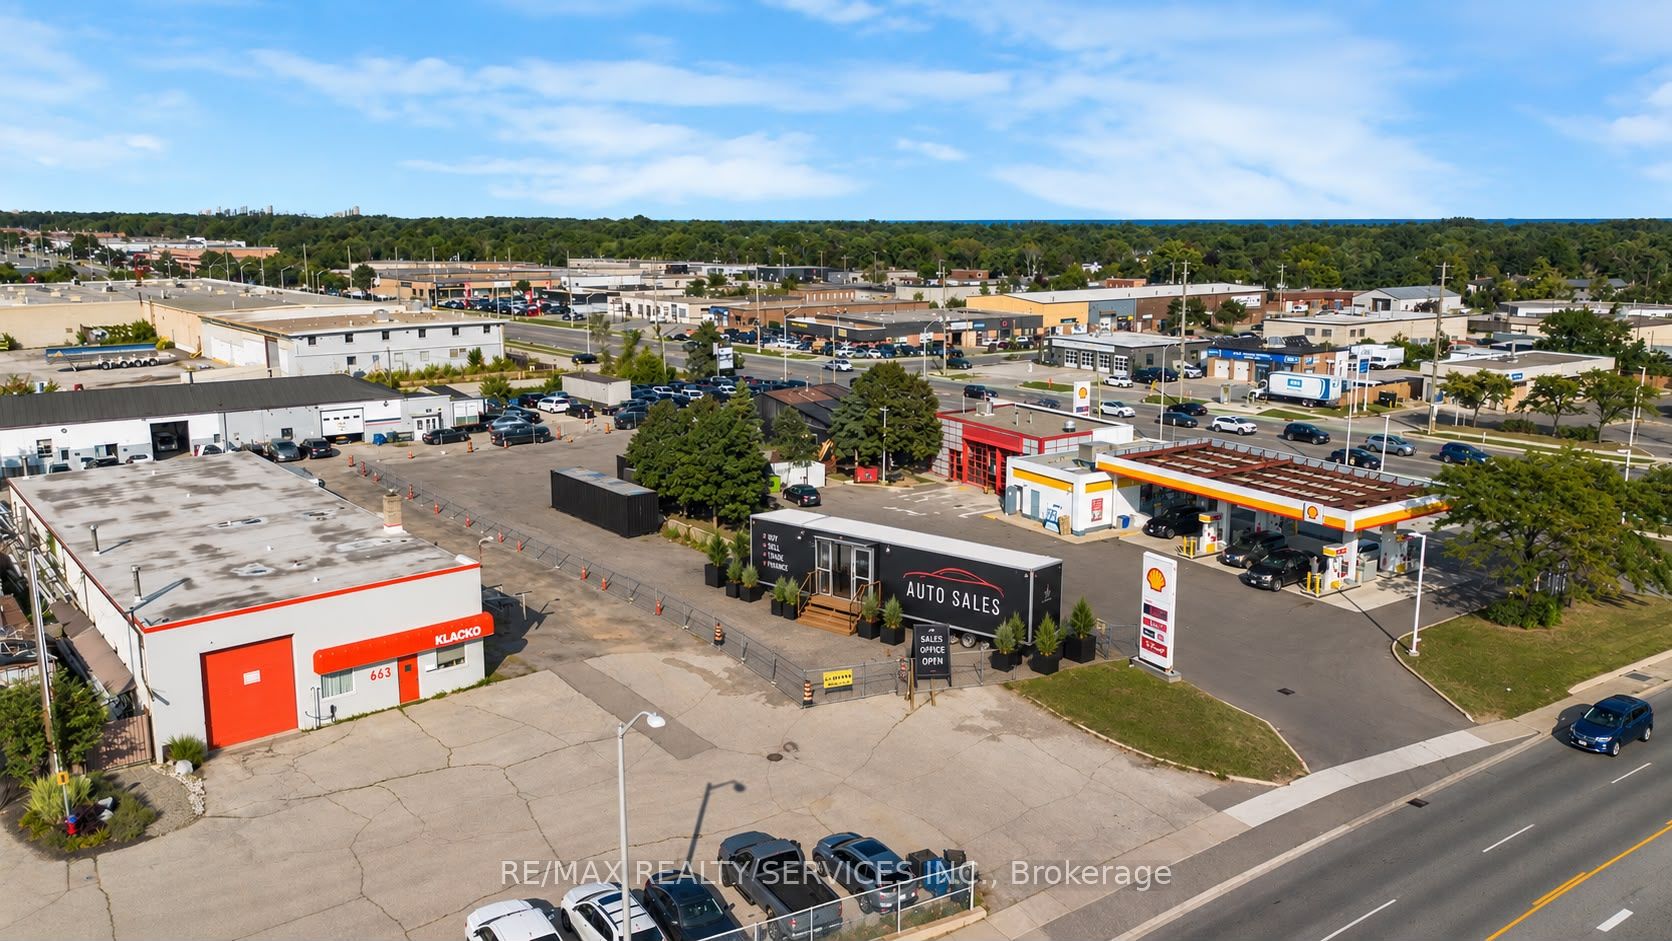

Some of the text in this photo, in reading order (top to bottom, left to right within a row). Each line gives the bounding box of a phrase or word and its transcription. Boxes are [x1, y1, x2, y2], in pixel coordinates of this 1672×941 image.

[906, 581, 1000, 616] AUTO SALES
[435, 626, 481, 645] KLACKO
[920, 635, 943, 643] SALES
[919, 646, 946, 654] OFFICE
[921, 657, 944, 666] OPEN
[370, 667, 391, 681] 663
